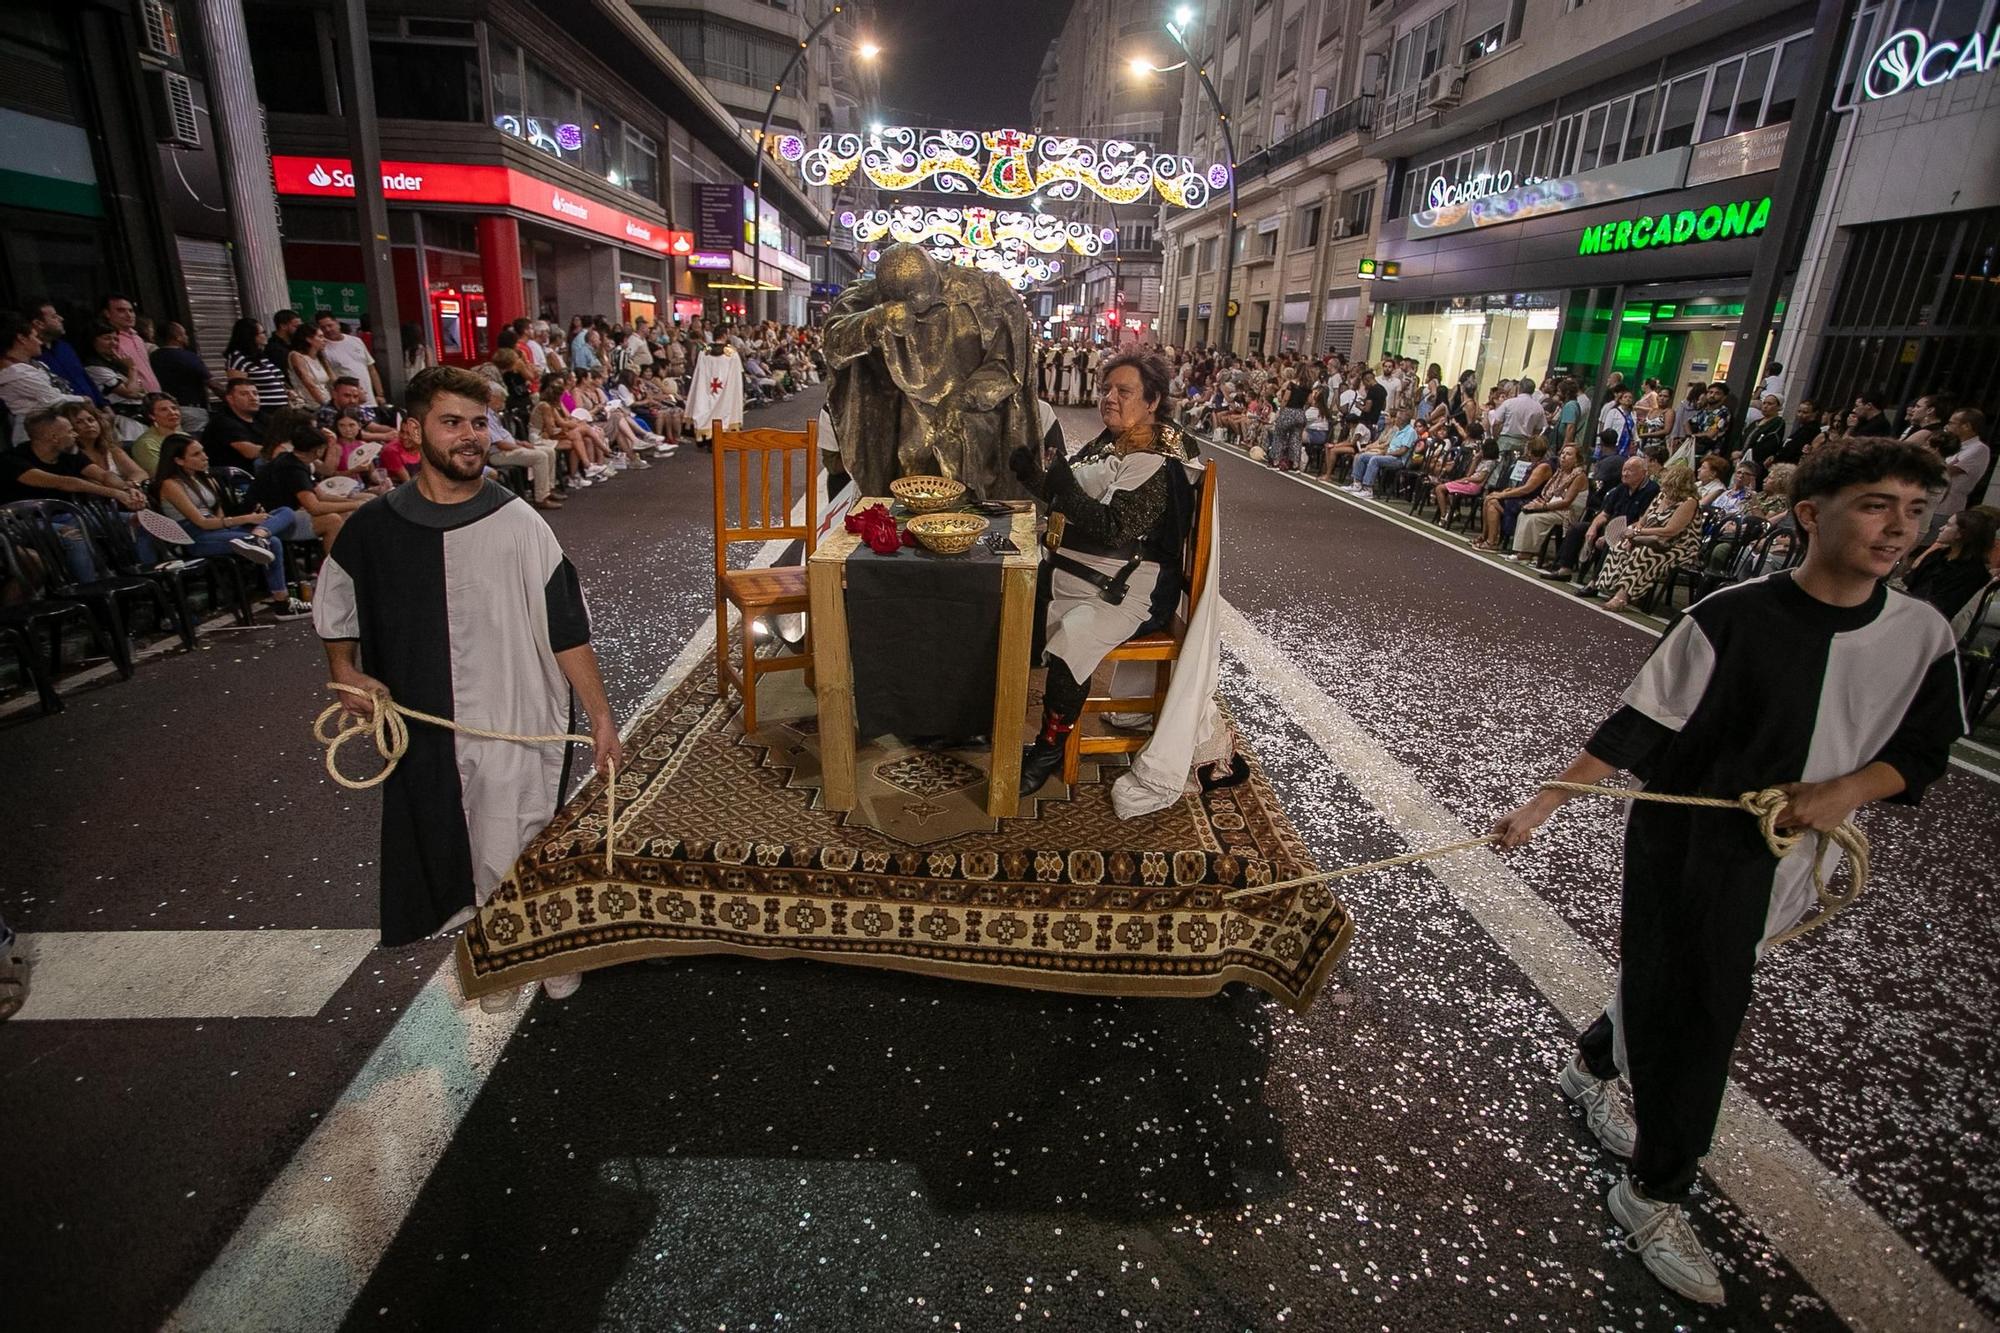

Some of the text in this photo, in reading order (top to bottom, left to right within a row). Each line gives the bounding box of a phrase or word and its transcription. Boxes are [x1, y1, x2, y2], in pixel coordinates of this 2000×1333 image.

[332, 169, 423, 191] Sander
[1444, 169, 1512, 207] CARRILLO
[1578, 196, 1772, 256] MERCADONA
